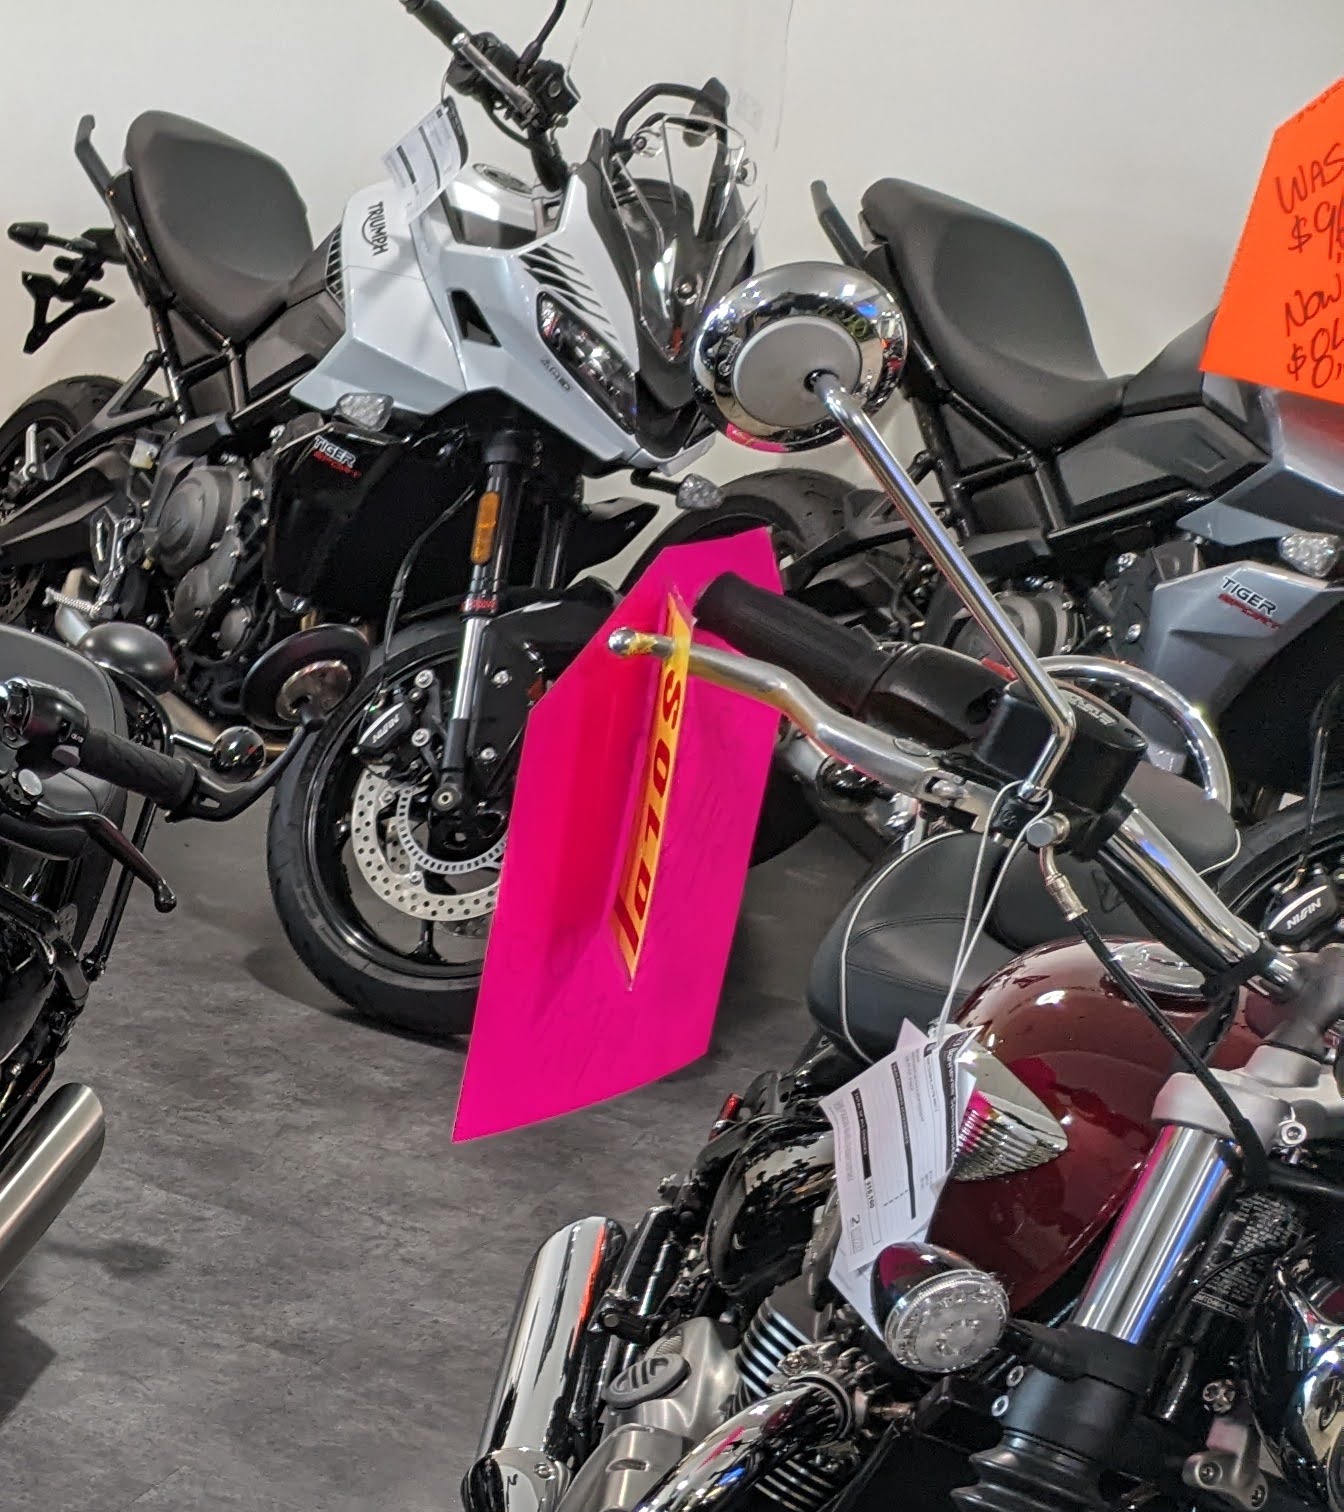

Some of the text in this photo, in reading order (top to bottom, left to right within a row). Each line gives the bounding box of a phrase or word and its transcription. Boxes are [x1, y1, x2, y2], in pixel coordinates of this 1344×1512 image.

[361, 201, 389, 256] TRIUMPH
[314, 435, 357, 468] TIGER
[1221, 576, 1277, 615] TIGER
